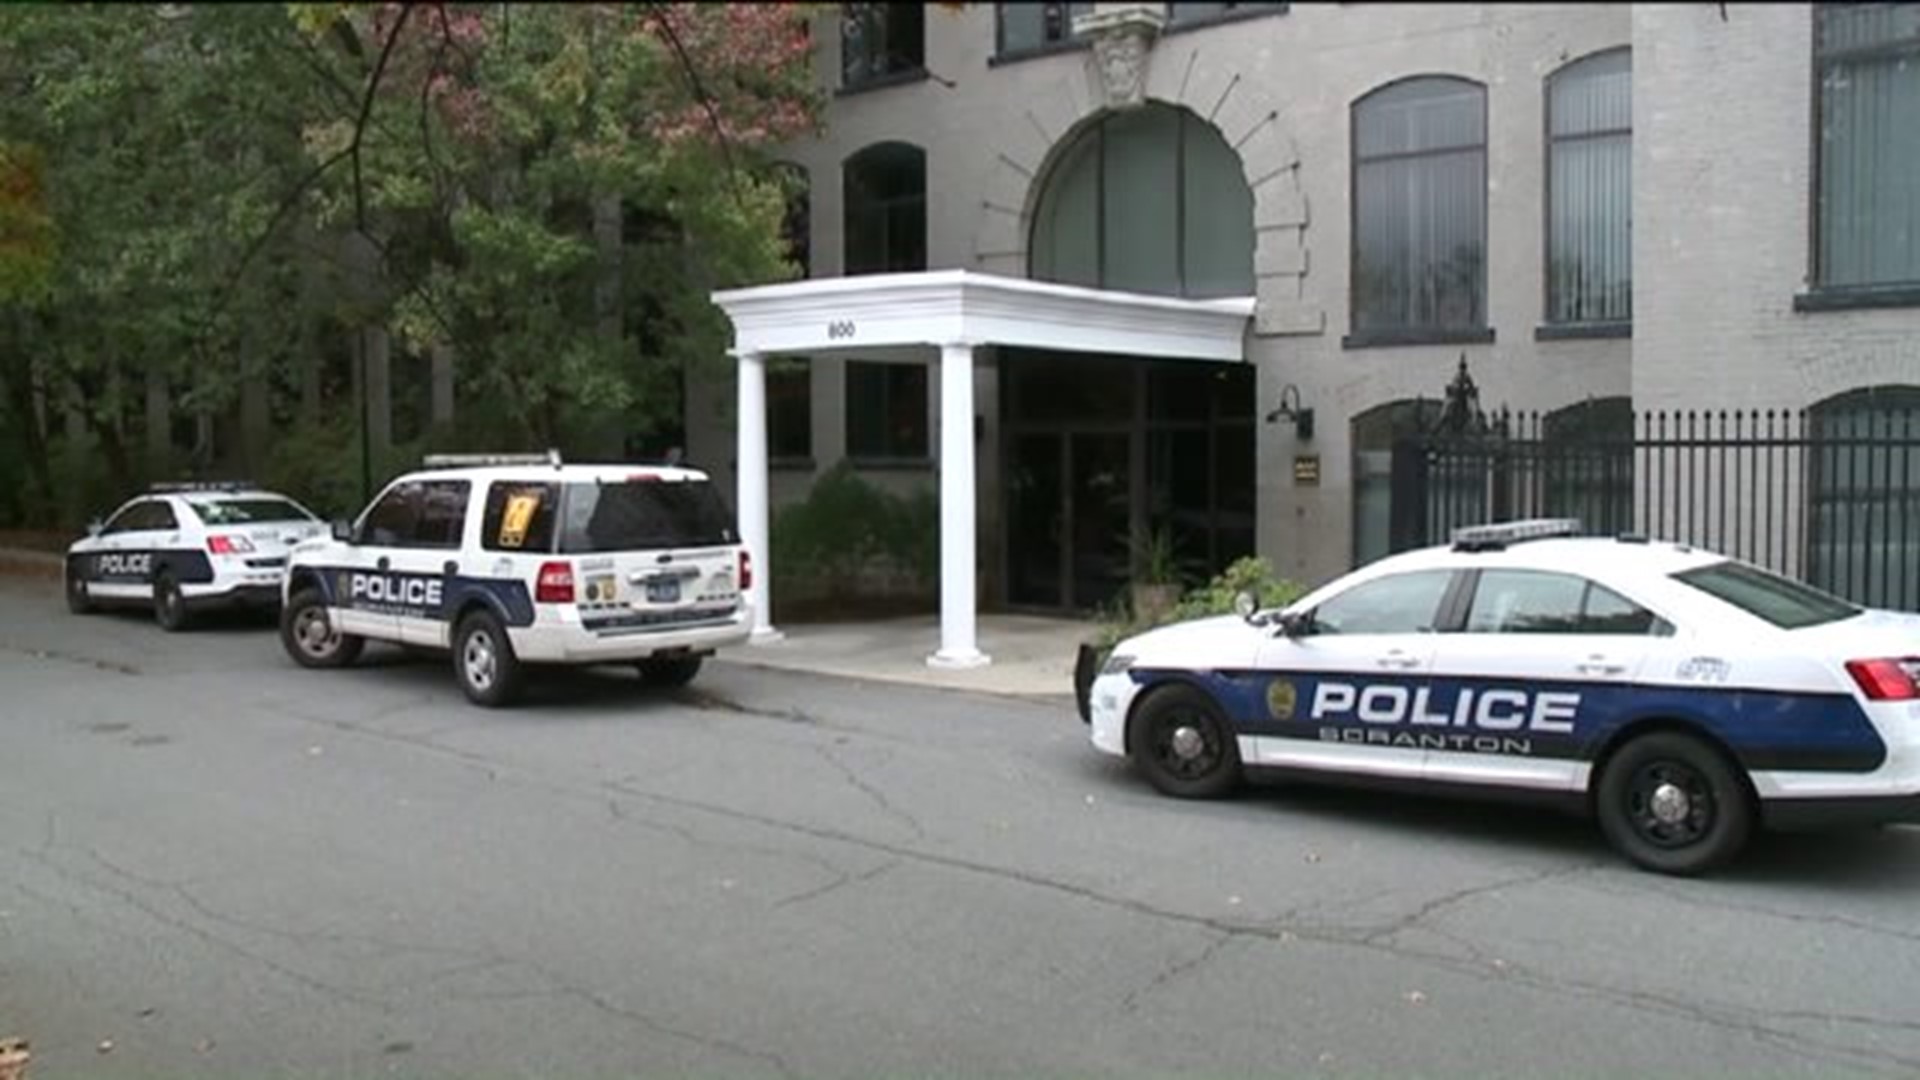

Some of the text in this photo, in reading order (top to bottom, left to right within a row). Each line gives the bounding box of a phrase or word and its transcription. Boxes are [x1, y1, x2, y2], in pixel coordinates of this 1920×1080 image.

[828, 320, 856, 340] 800
[100, 554, 152, 574] POLICE
[351, 574, 443, 605] POLICE
[1311, 682, 1581, 734] POLICE
[1318, 727, 1533, 754] SCRANTON
